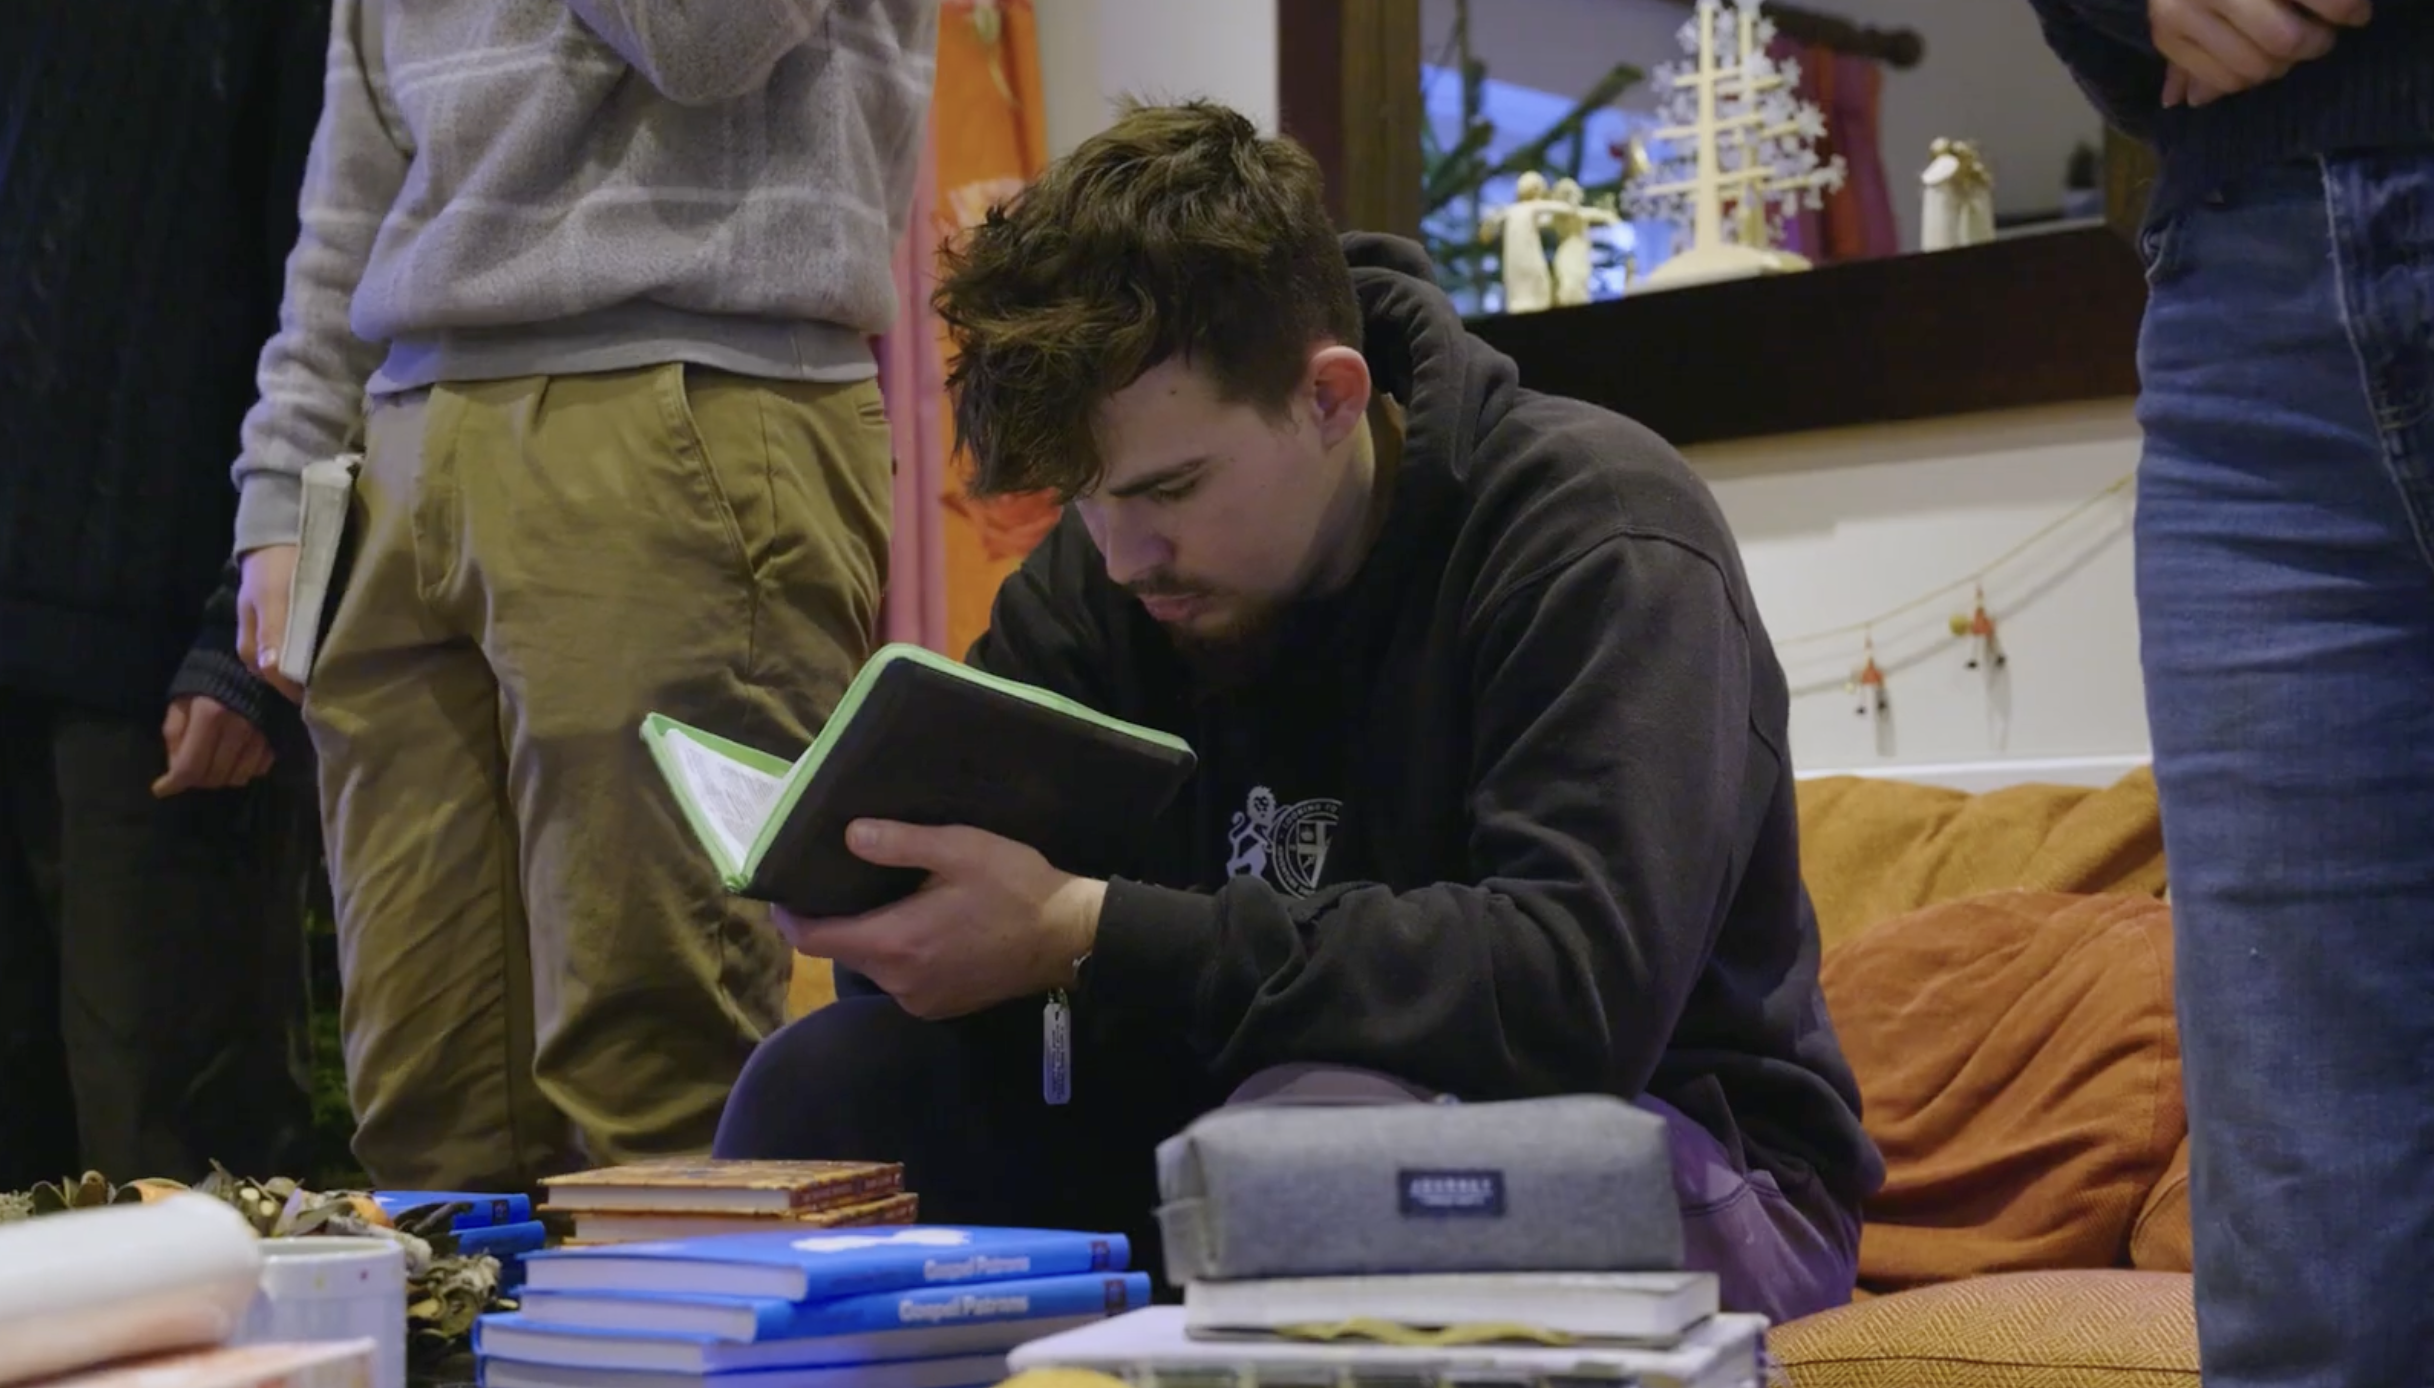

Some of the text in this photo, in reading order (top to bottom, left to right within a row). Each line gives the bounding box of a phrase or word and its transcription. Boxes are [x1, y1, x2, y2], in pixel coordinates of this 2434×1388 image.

[924, 1257, 974, 1280] Gospel
[977, 1255, 1030, 1273] Patrons
[899, 1295, 1029, 1322] Gospel Patrons
